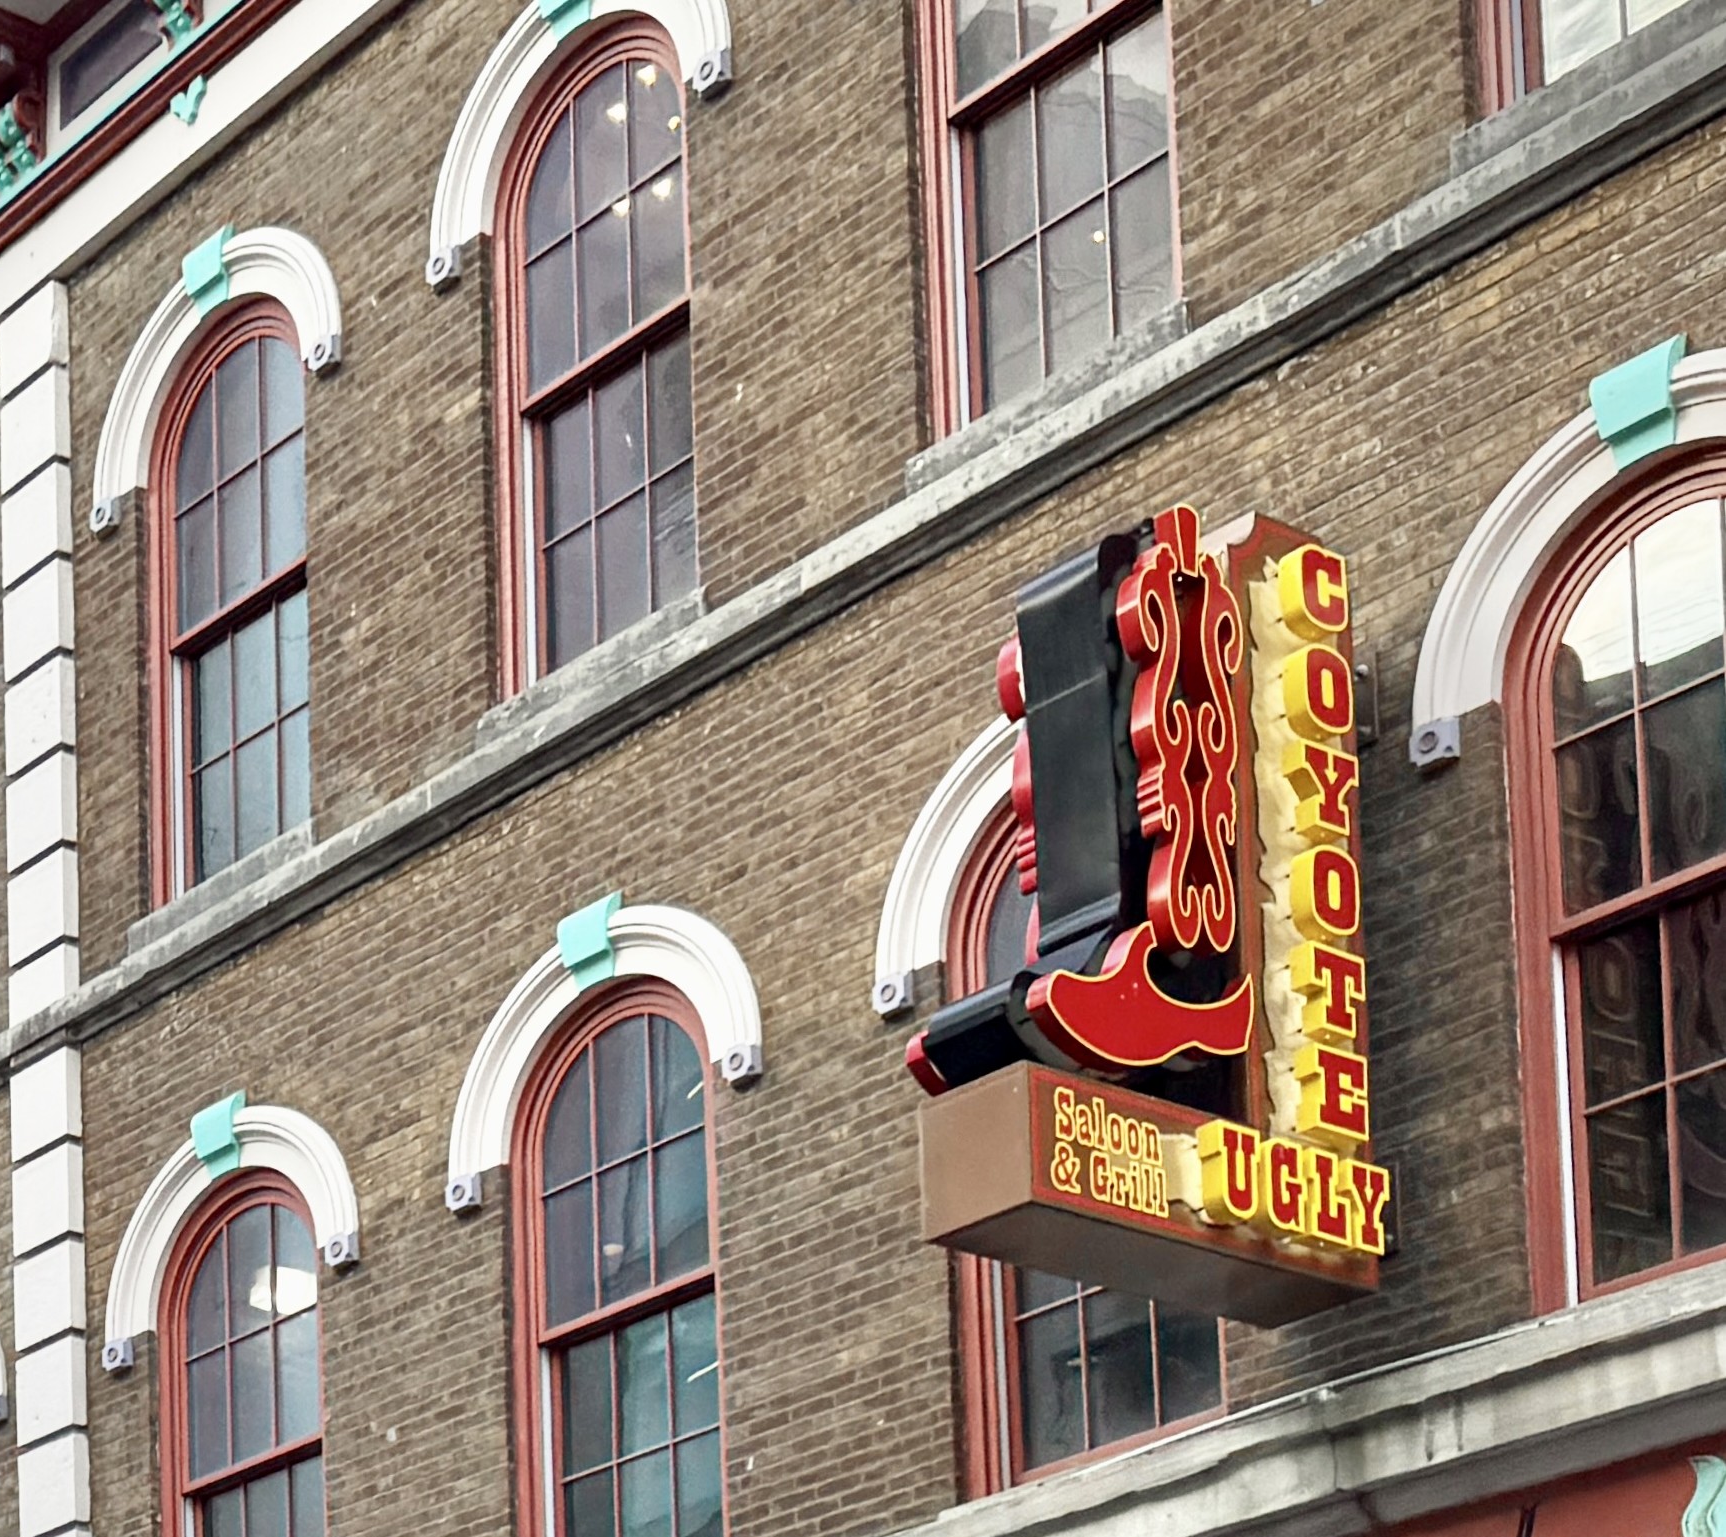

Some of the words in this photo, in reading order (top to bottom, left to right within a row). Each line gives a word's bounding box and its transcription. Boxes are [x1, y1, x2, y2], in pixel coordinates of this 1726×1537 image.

[1279, 543, 1369, 1142] COYOTE
[1054, 1086, 1163, 1166] Saloon
[1050, 1144, 1082, 1195] &
[1089, 1151, 1170, 1219] Grill
[1196, 1119, 1390, 1256] UGLY
